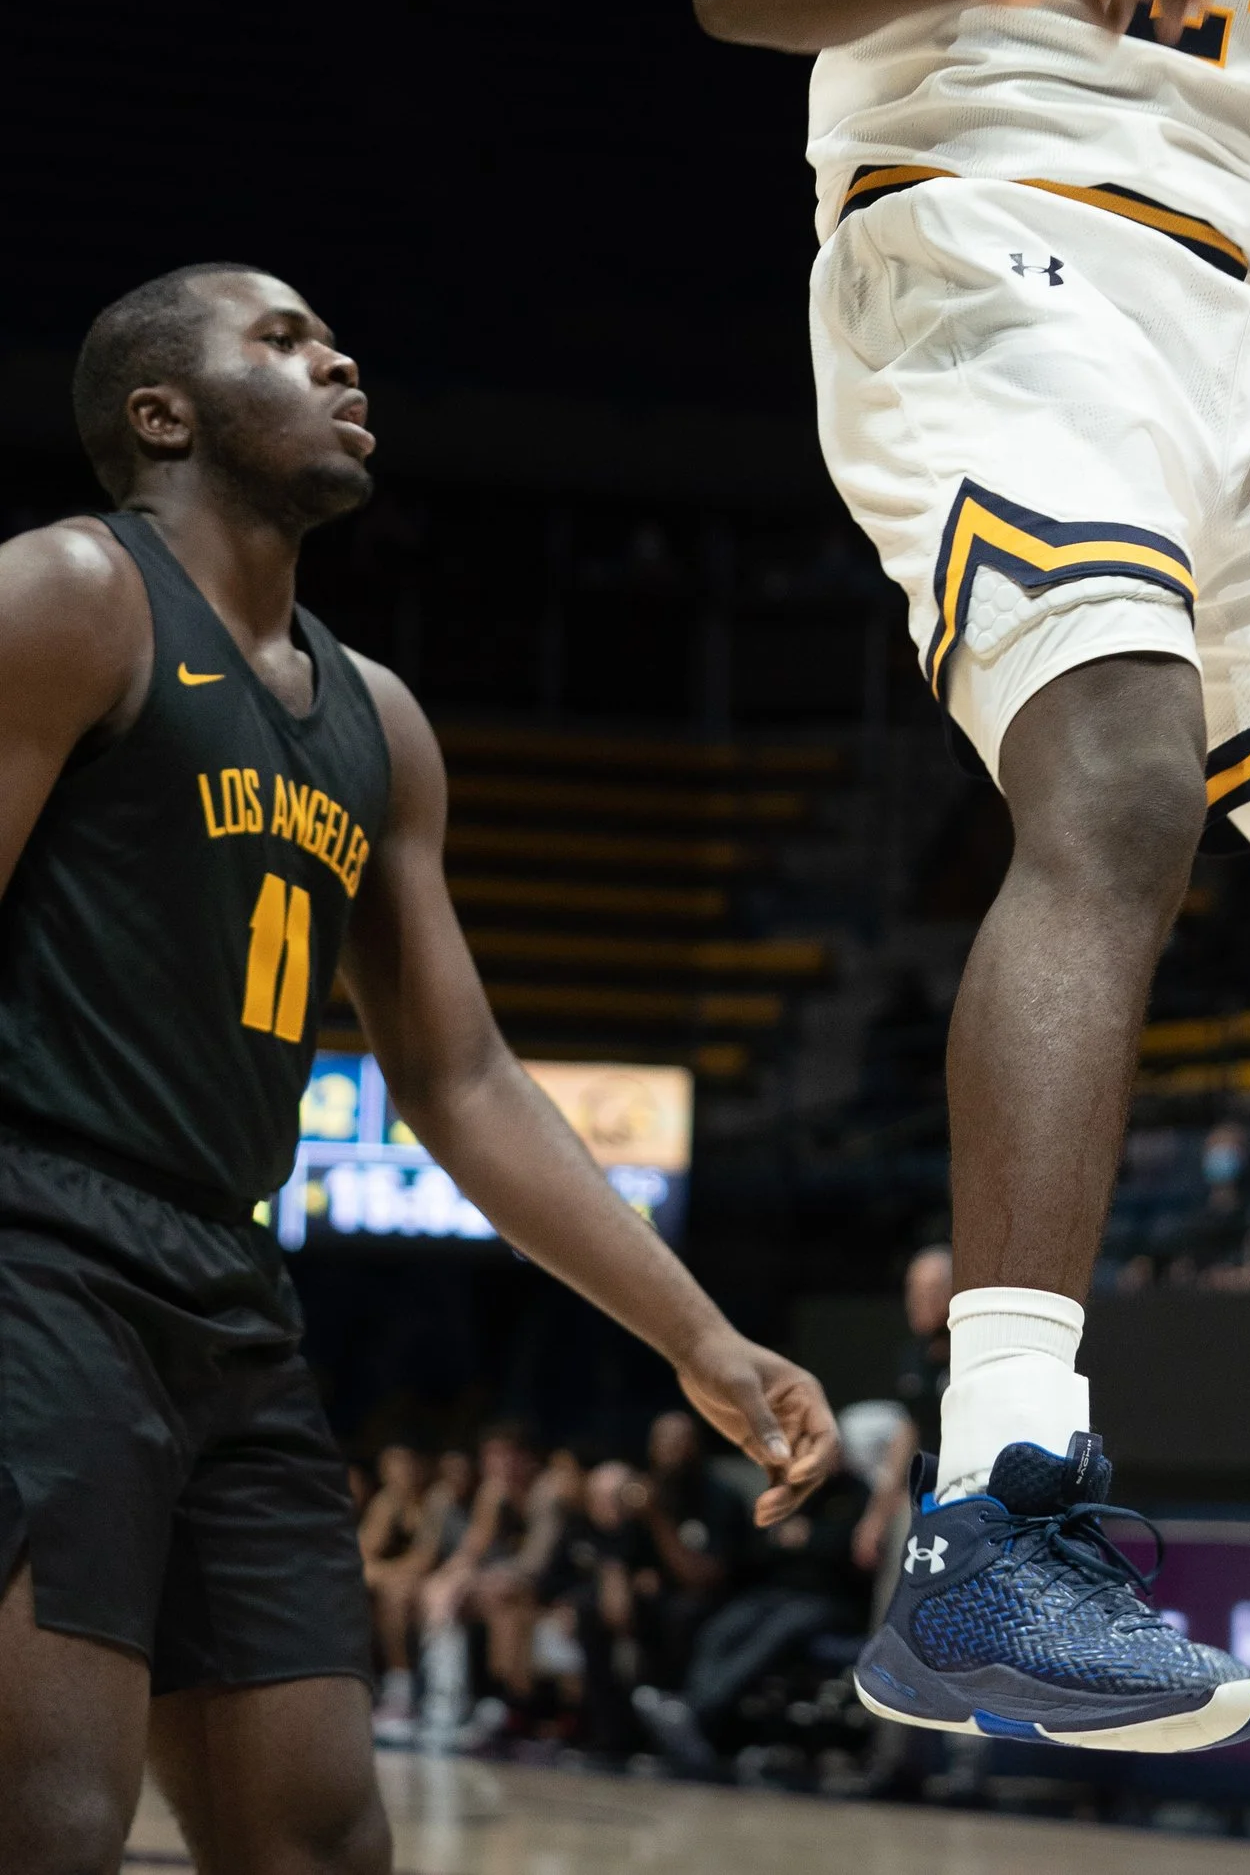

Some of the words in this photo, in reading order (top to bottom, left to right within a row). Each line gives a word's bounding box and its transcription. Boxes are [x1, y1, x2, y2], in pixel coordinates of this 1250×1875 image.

[198, 768, 263, 838] LOS
[271, 773, 370, 898] ANGELES
[241, 872, 310, 1044] 11
